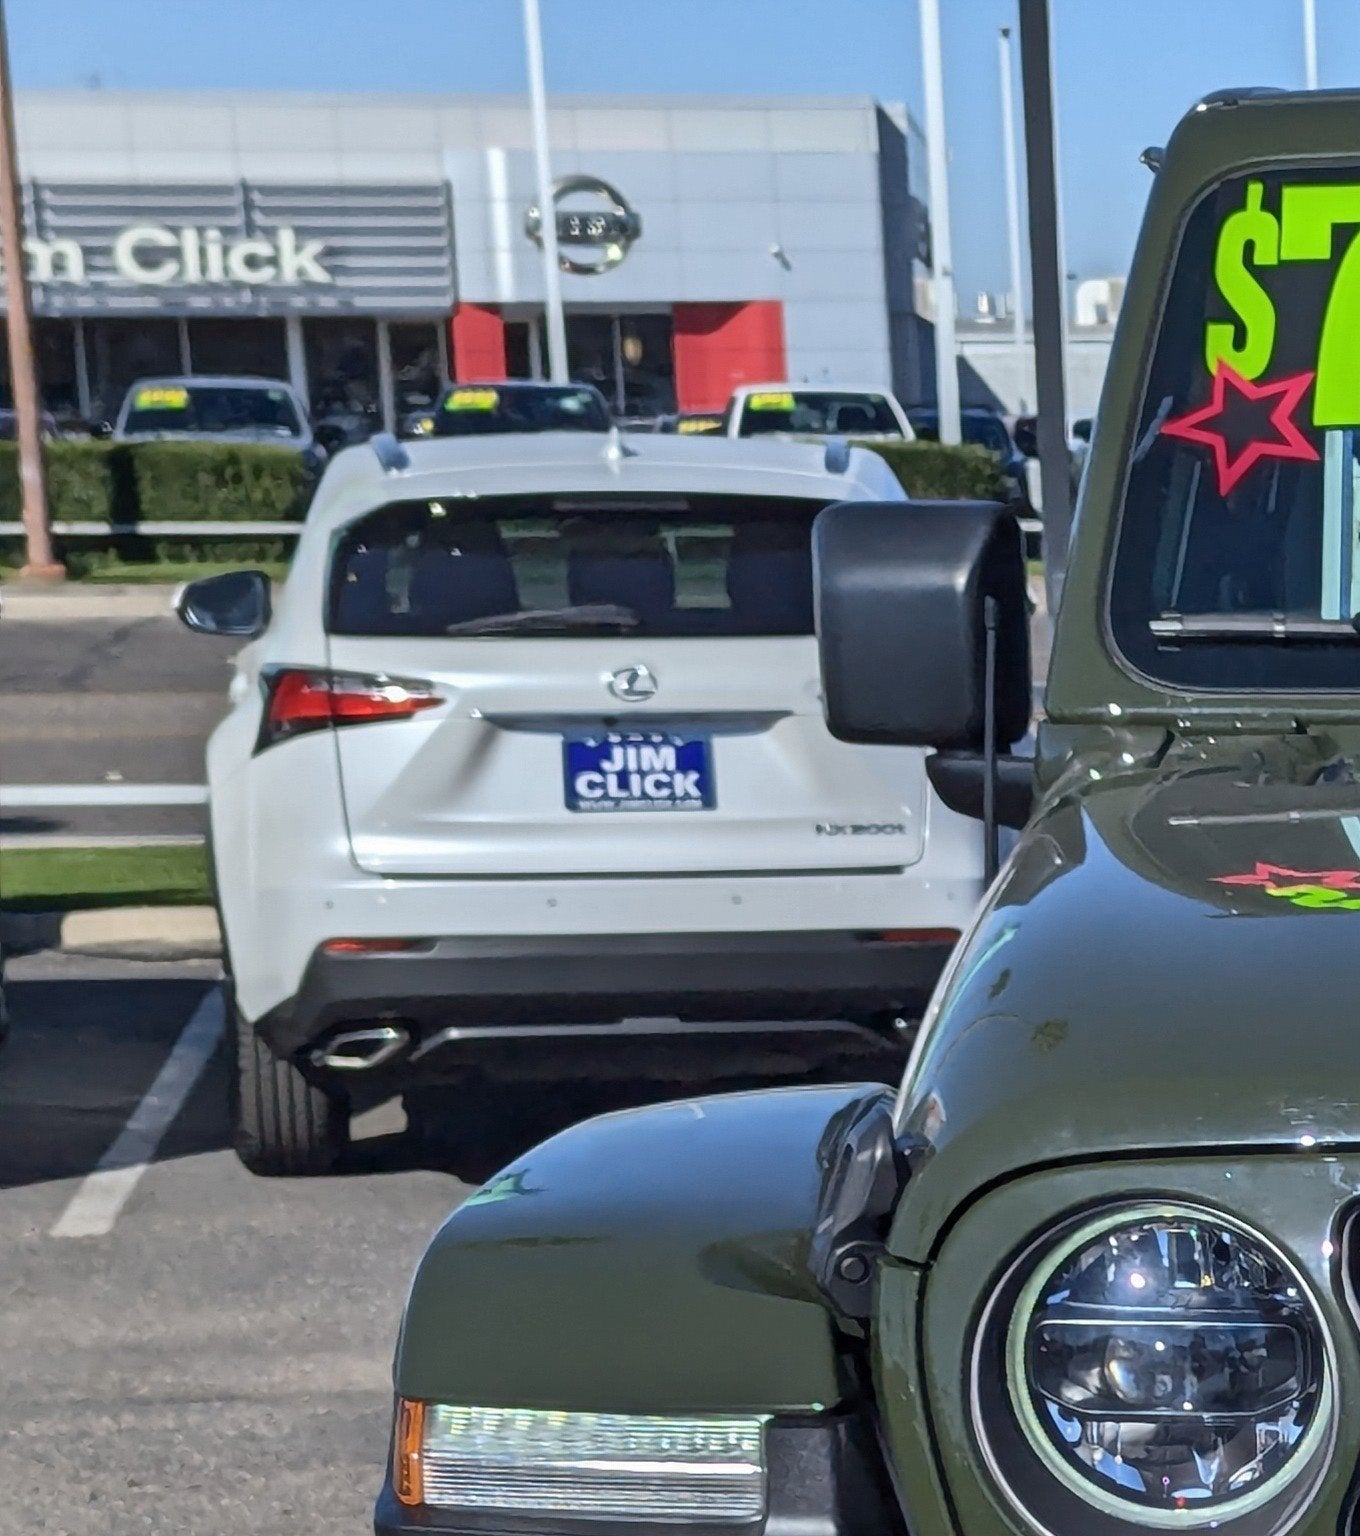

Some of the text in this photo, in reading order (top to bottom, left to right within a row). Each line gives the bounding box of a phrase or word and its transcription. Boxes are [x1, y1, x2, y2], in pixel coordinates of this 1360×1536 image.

[113, 223, 333, 285] Click
[600, 745, 676, 772] JIM
[575, 770, 702, 798] CLICK
